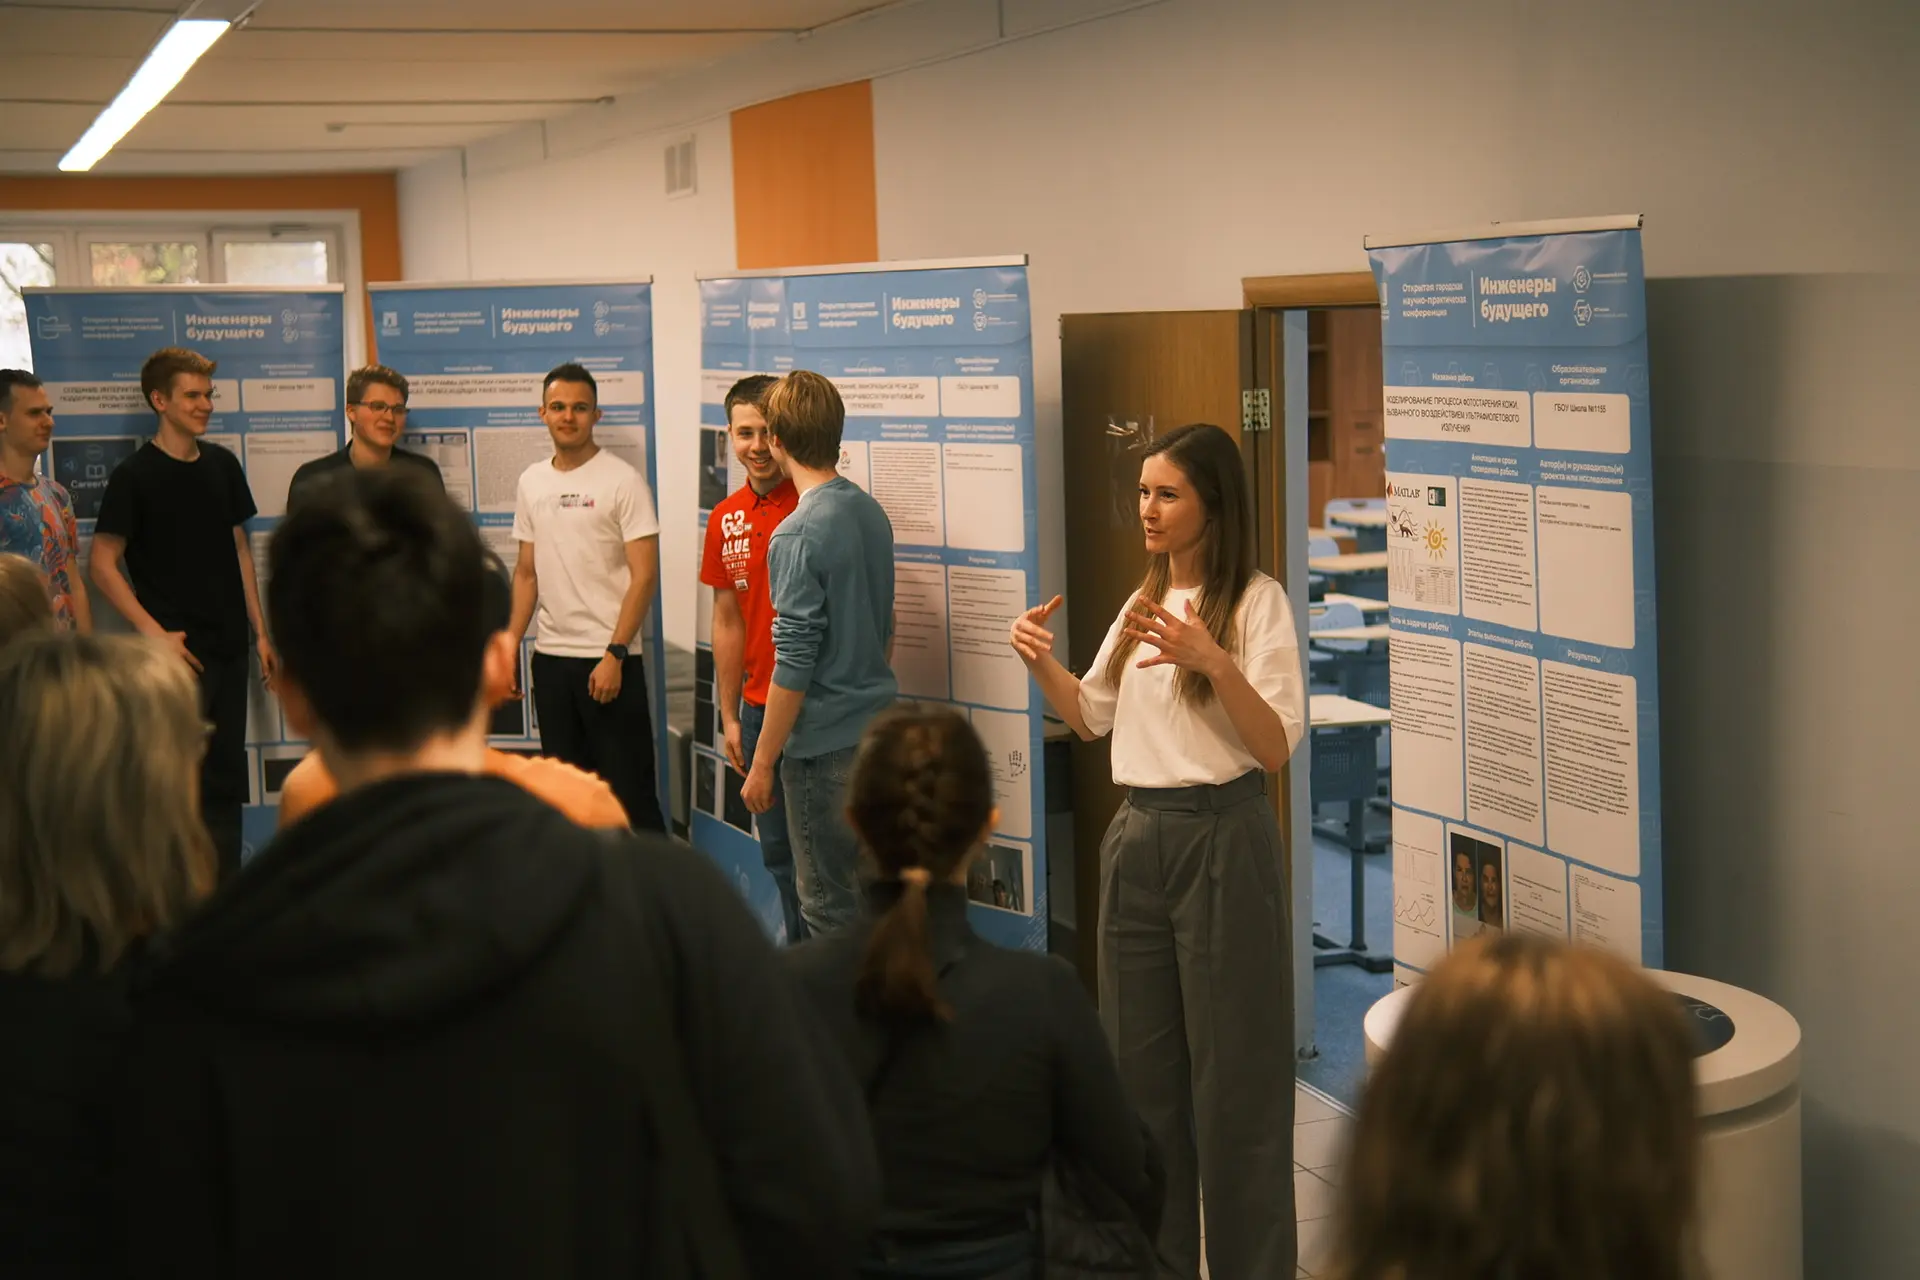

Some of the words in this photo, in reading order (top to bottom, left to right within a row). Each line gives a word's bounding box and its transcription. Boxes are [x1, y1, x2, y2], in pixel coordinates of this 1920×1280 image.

[1480, 276, 1557, 298] Инженеры
[892, 297, 960, 312] Инженеры
[1481, 299, 1549, 322] будущего
[185, 314, 272, 326] Инженеры
[502, 308, 580, 320] Инженеры
[892, 313, 954, 329] будущего
[186, 327, 265, 341] будущего
[502, 320, 573, 336] будущего
[1434, 397, 1462, 406] ПРОЦЕССА
[1463, 399, 1502, 408] ФОТОСТАРЕНИЯ
[1554, 403, 1568, 412] ГБОУ
[1570, 404, 1588, 412] Школа
[1421, 408, 1464, 420] ВОЗДЕЙСТВИЕМ
[70, 478, 109, 489] Career
[1394, 486, 1420, 498] MATLAB
